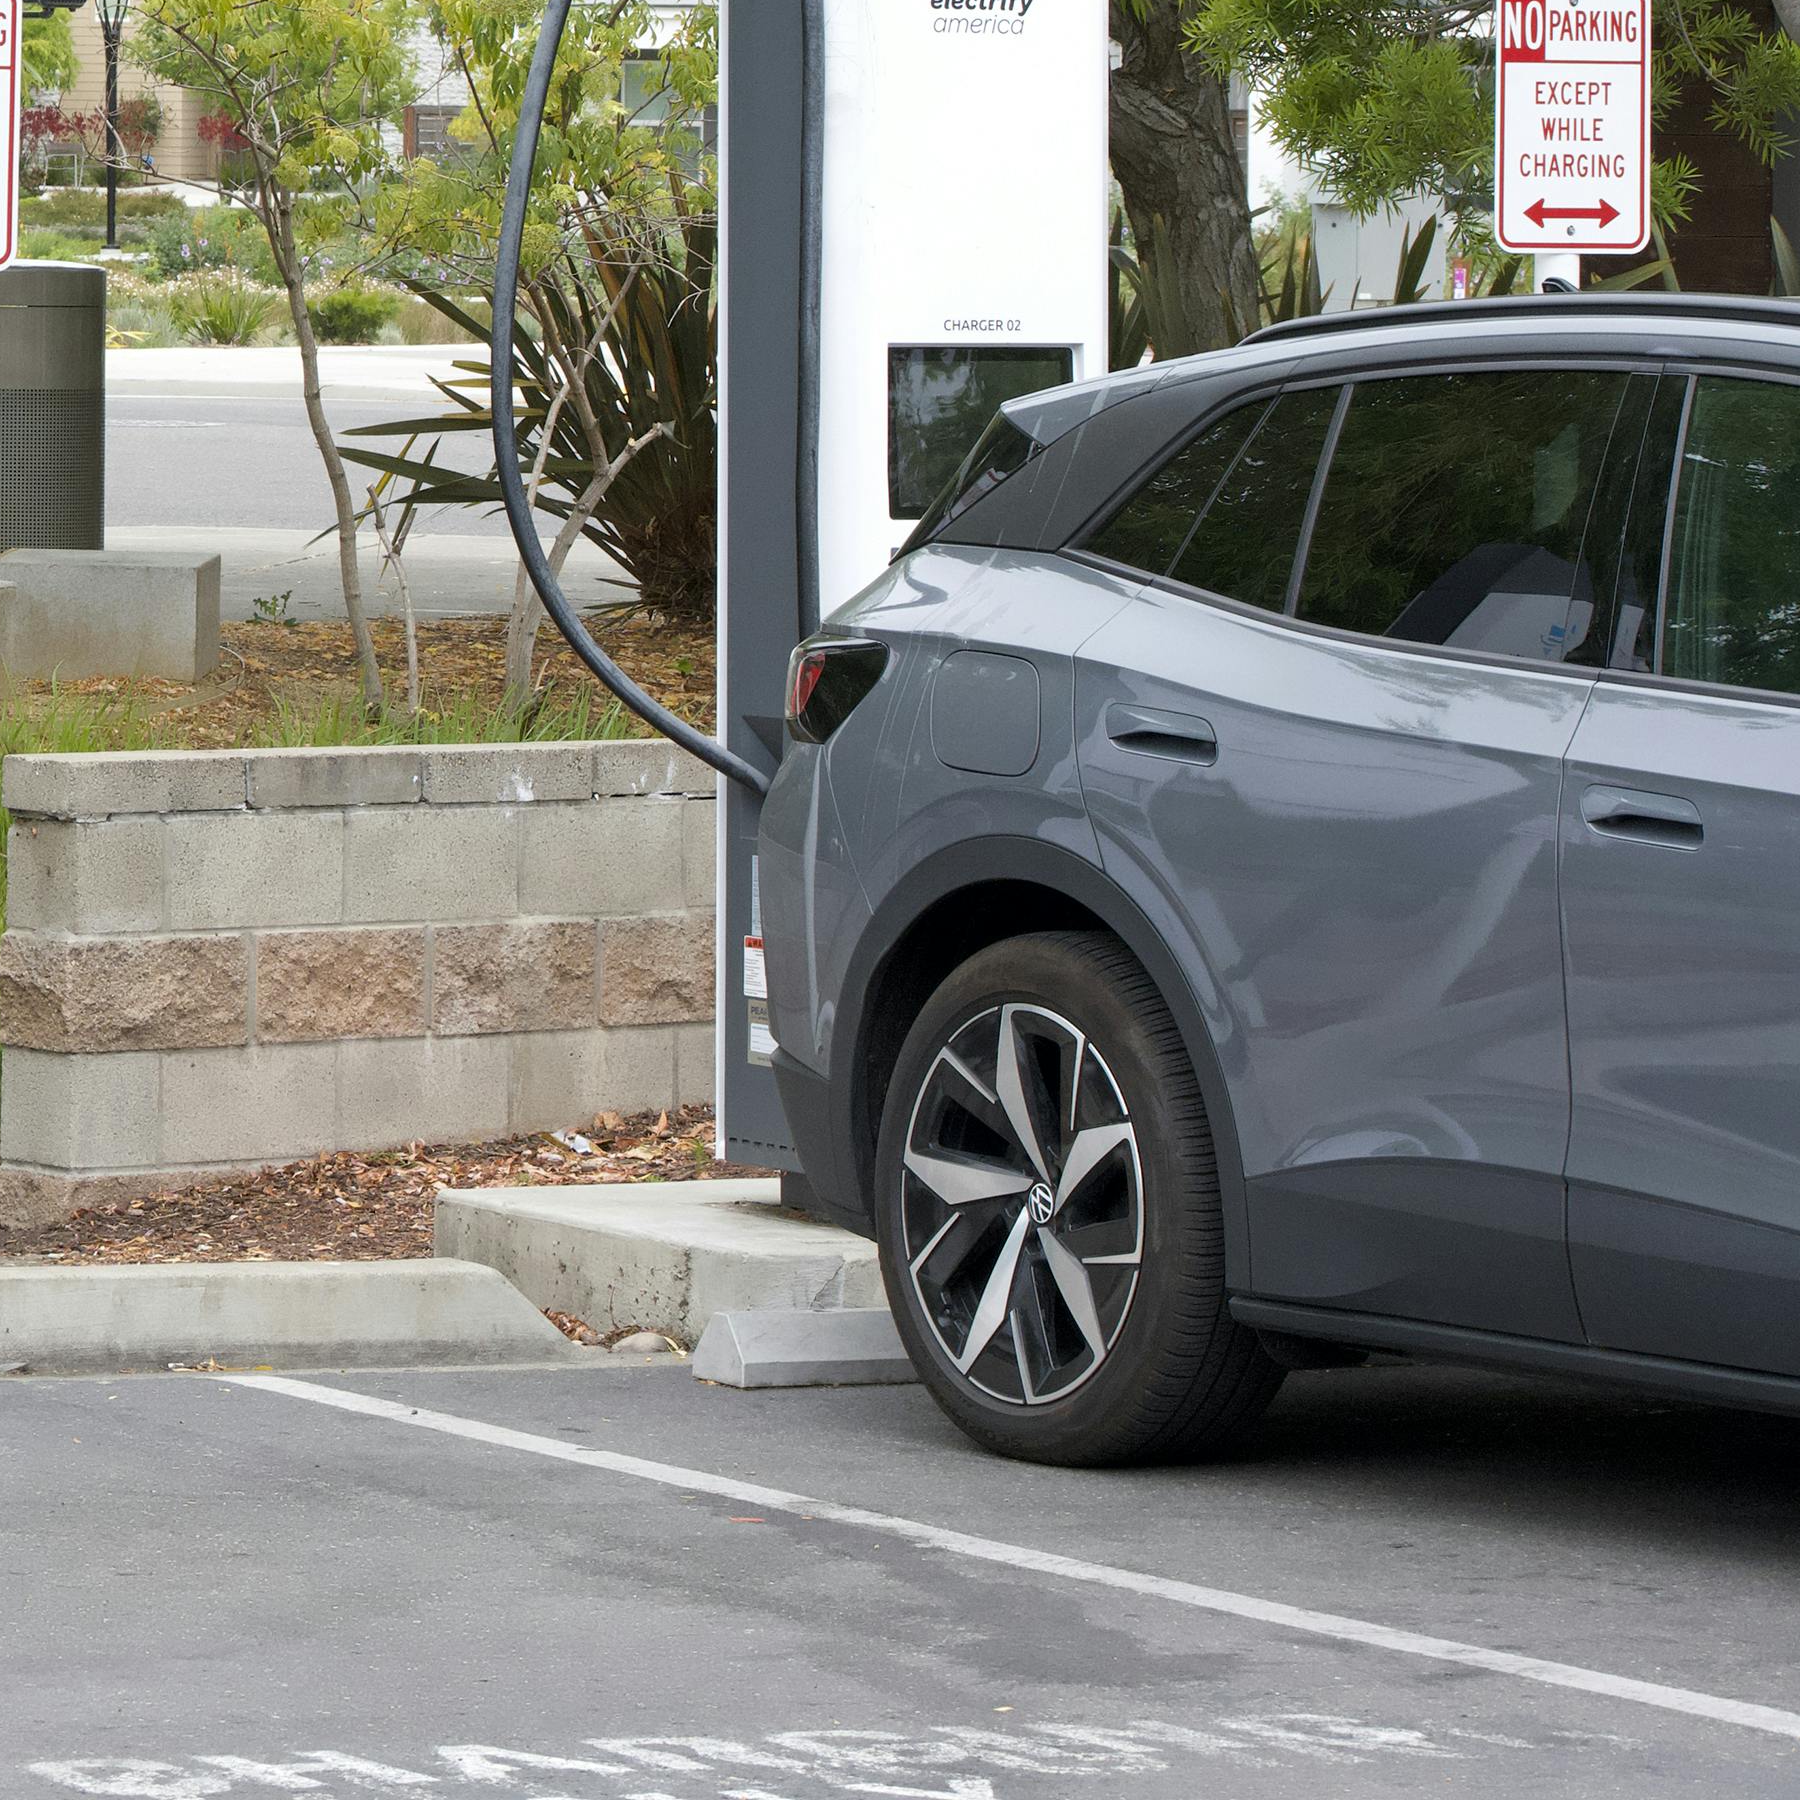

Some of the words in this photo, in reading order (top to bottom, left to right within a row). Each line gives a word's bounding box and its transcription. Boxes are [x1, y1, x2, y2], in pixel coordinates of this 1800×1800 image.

[933, 15, 1025, 34] america
[1504, 0, 1544, 50] NO
[1549, 10, 1637, 42] PARKING
[1536, 81, 1612, 106] EXCEPT
[1542, 117, 1604, 142] WHILE
[1519, 153, 1625, 179] CHARGING
[943, 319, 1004, 332] CHARGER
[1006, 319, 1021, 332] 02
